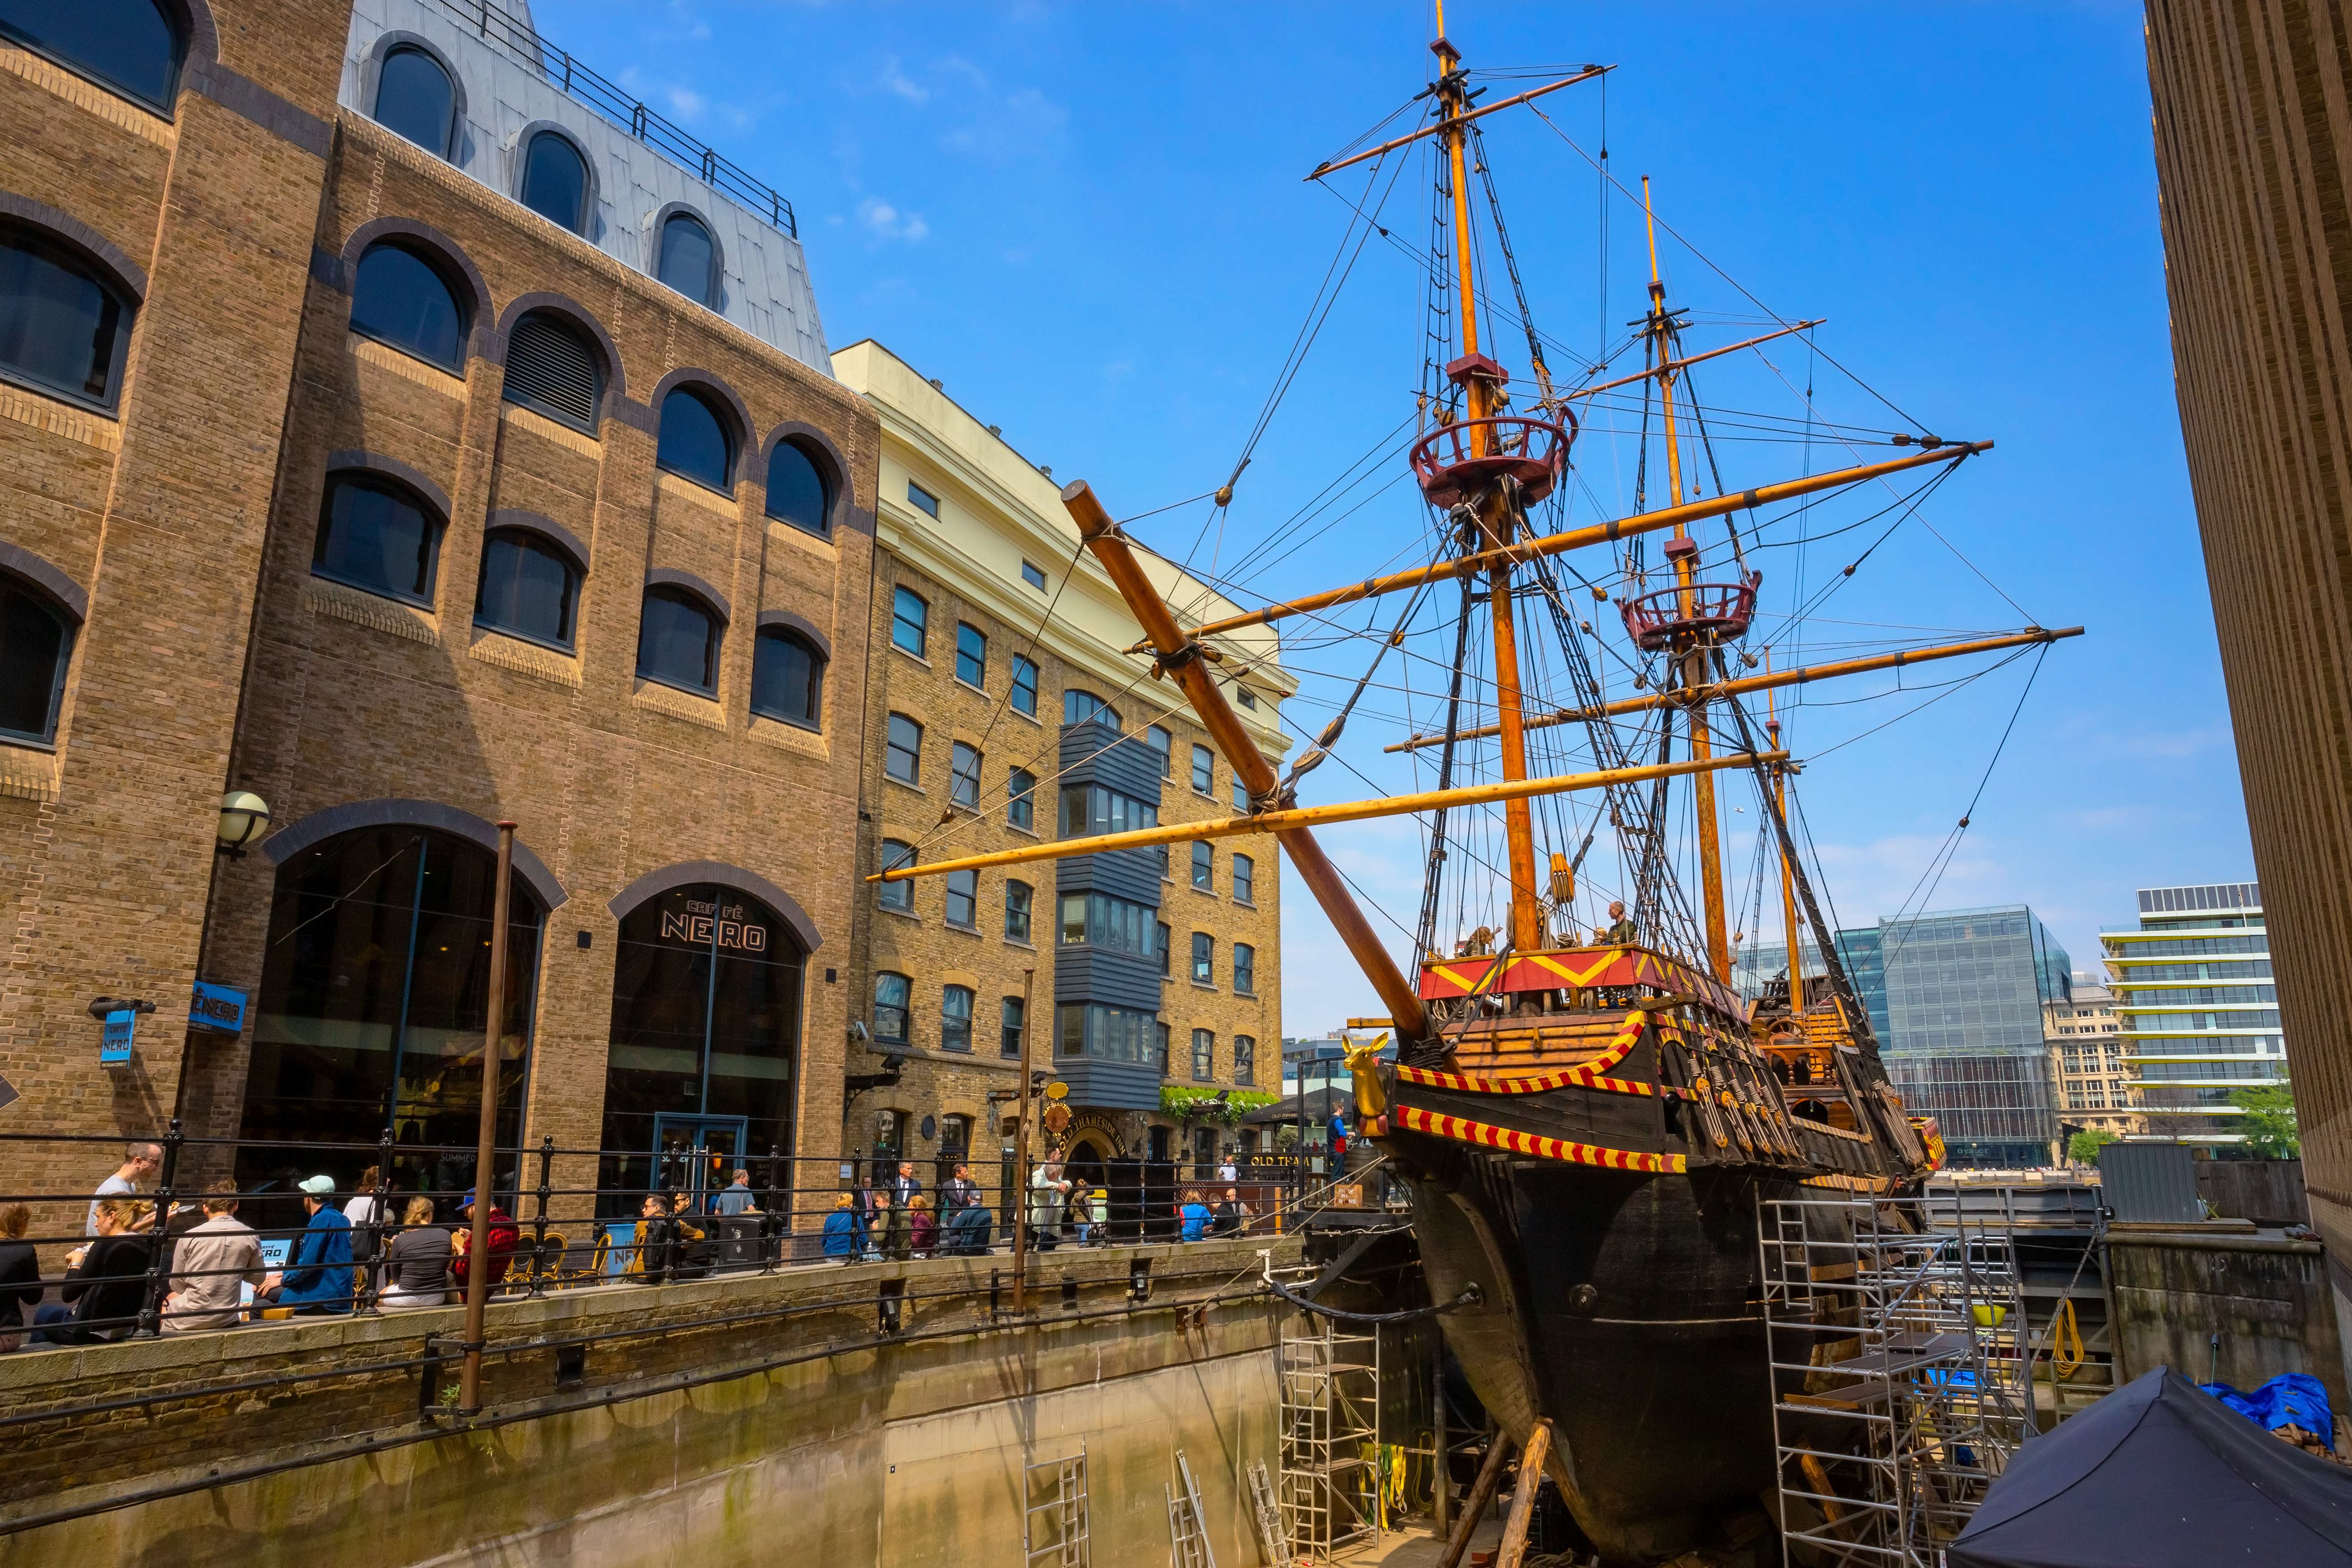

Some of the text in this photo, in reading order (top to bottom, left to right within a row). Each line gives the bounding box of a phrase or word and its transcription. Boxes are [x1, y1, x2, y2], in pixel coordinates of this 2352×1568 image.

[661, 910, 766, 952] NERO
[204, 995, 240, 1022] NERO
[103, 1038, 130, 1052] NERO
[1059, 1115, 1126, 1155] OLD THAMESIDE INN
[1251, 1156, 1274, 1166] OLD
